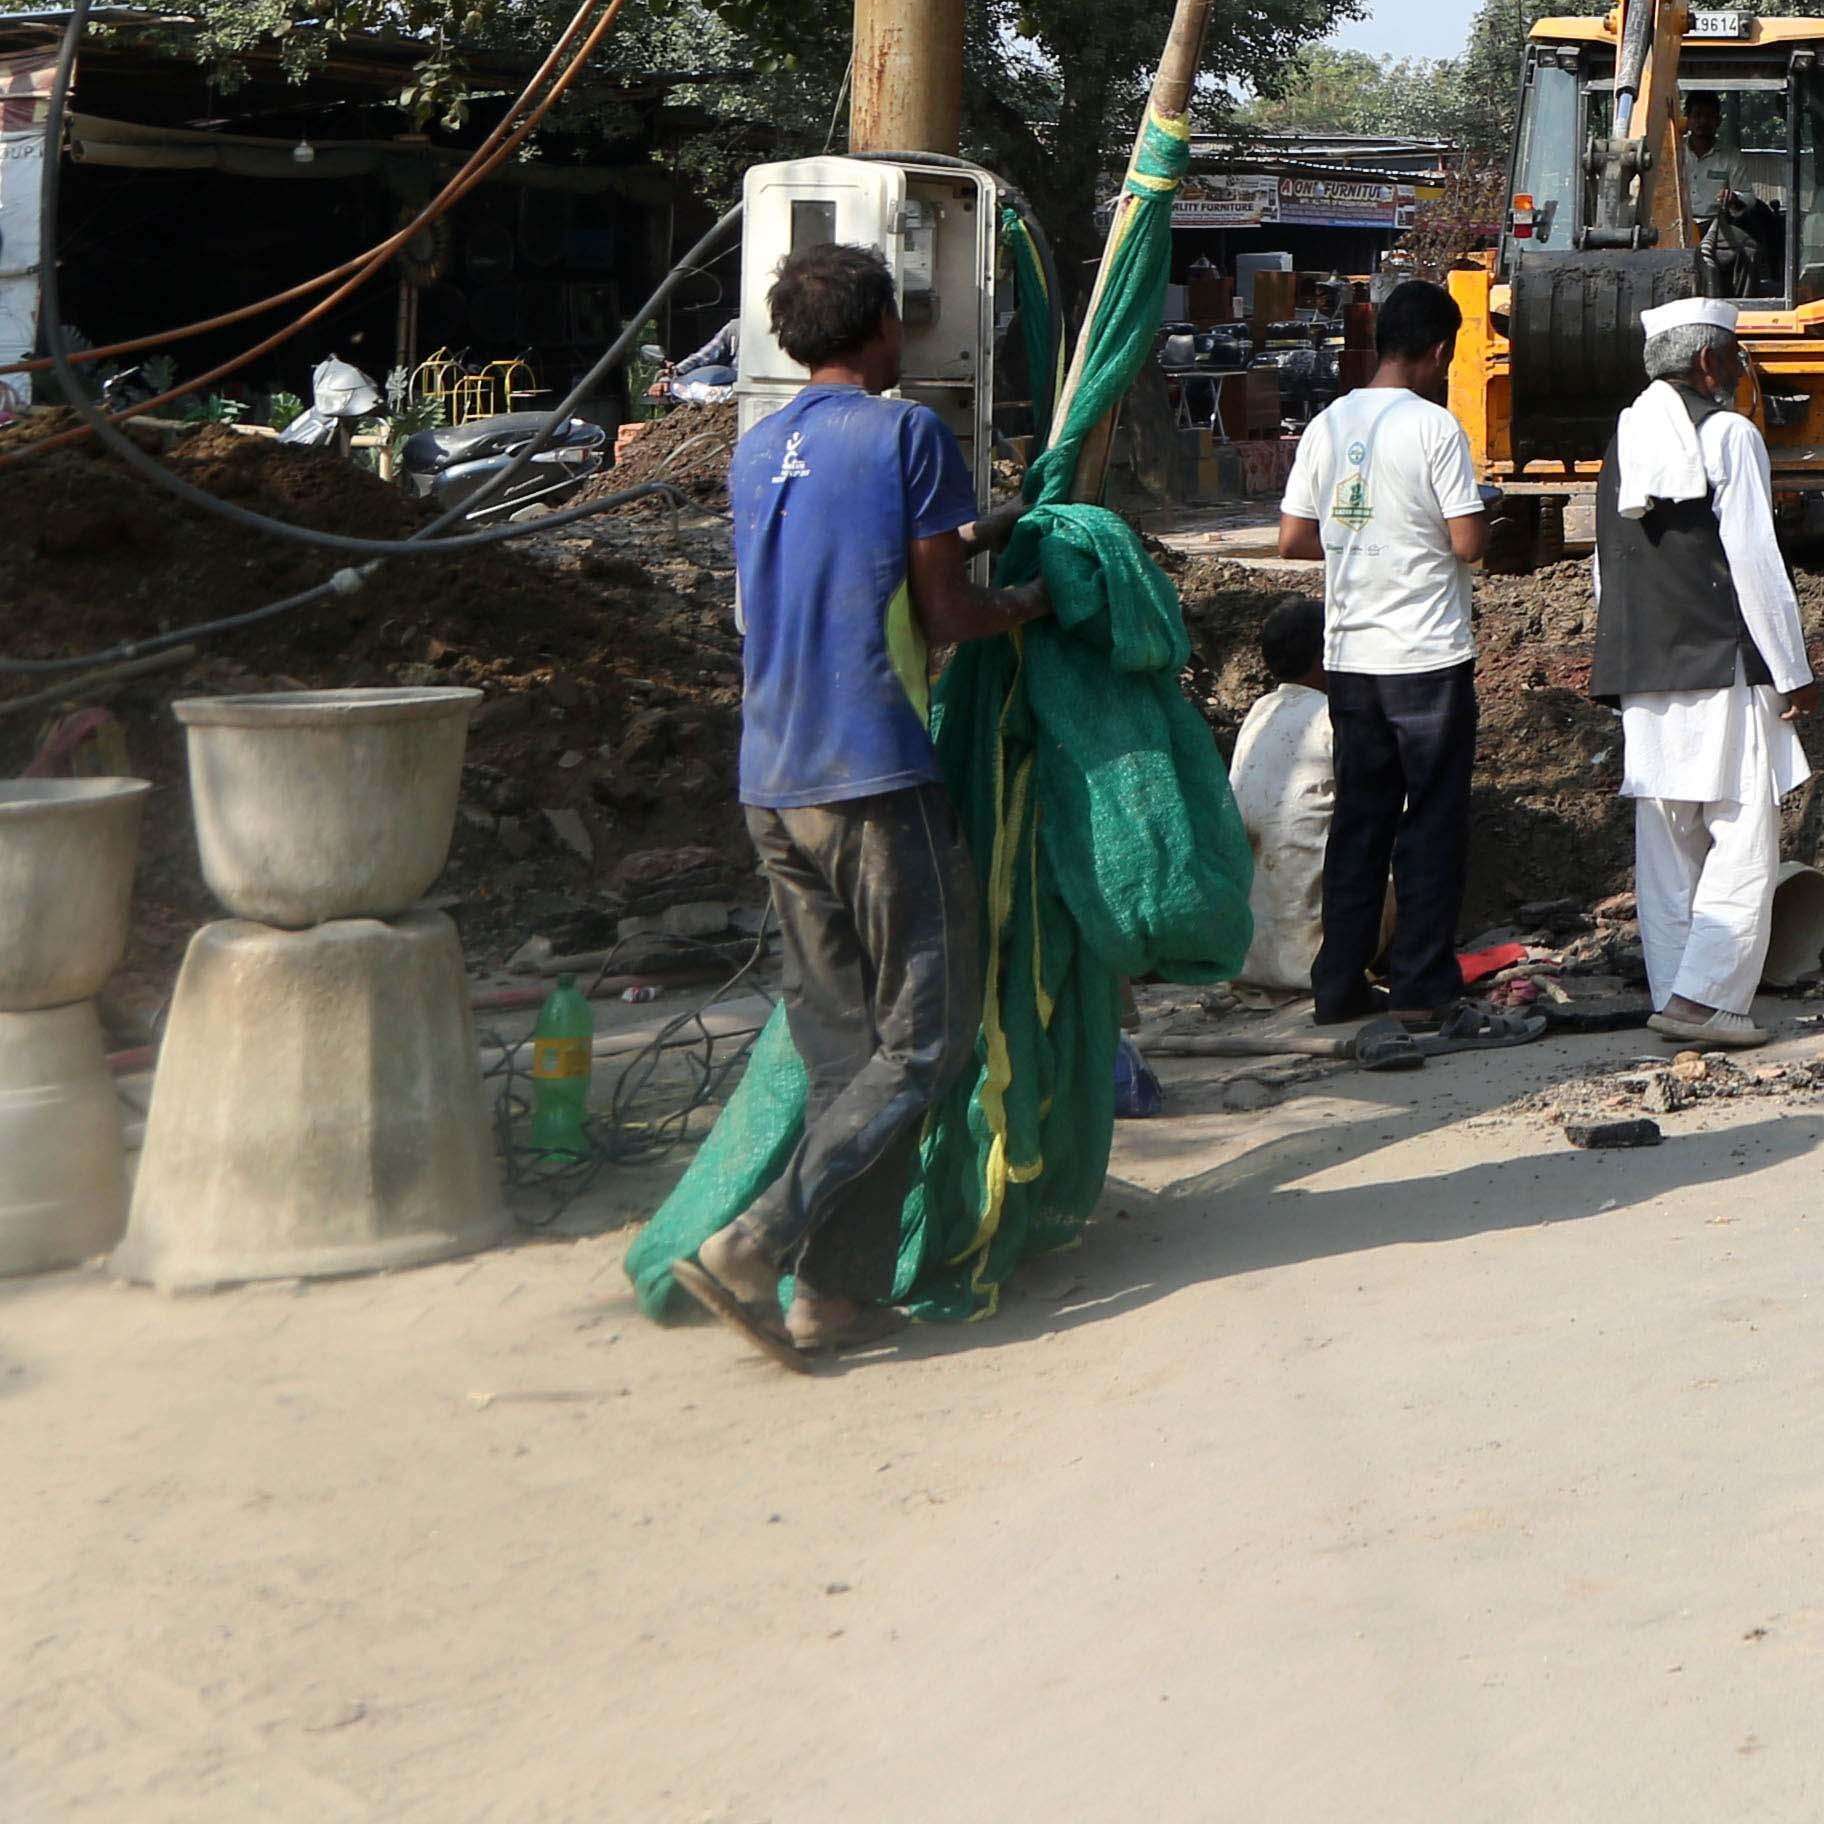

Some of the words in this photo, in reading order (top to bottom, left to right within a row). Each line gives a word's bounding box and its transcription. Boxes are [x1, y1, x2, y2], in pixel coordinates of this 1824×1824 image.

[1281, 179, 1293, 196] A
[1295, 180, 1314, 196] ON
[1323, 181, 1393, 201] FURNITU
[1201, 203, 1254, 212] FURNITURE
